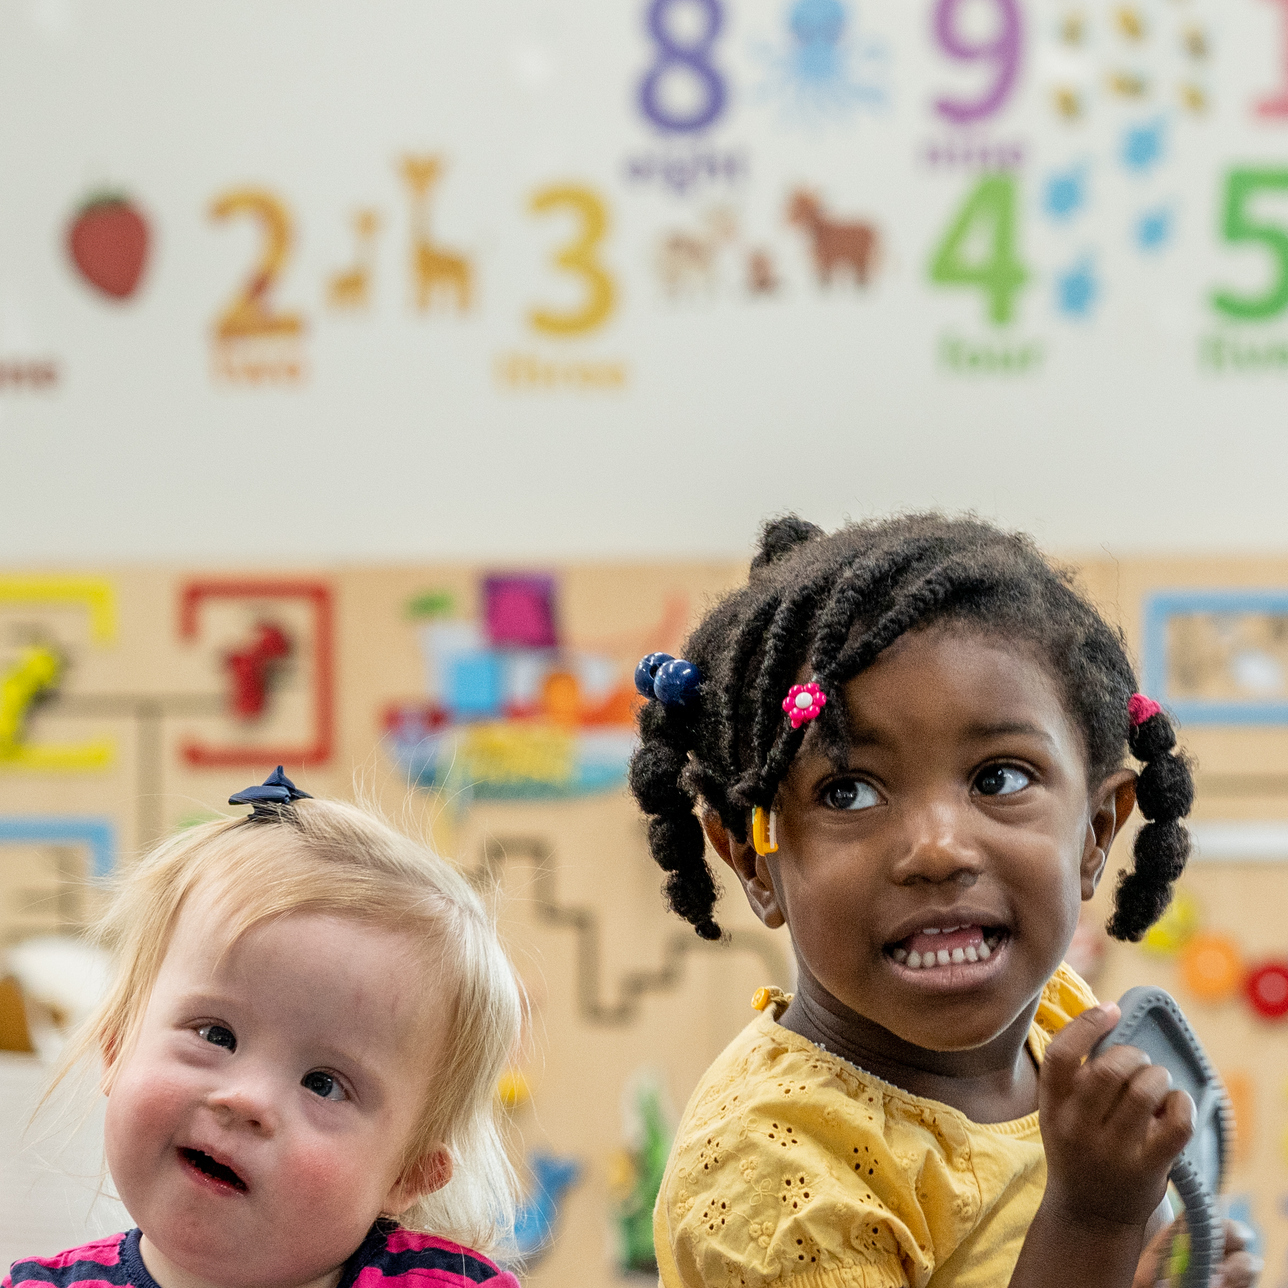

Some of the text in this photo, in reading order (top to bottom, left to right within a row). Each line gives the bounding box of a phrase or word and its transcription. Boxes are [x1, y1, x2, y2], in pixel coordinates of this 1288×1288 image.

[633, 0, 732, 138] 8
[927, 0, 1028, 126] 9
[209, 184, 309, 342] 2
[523, 182, 620, 338] 3
[923, 170, 1033, 330] 4
